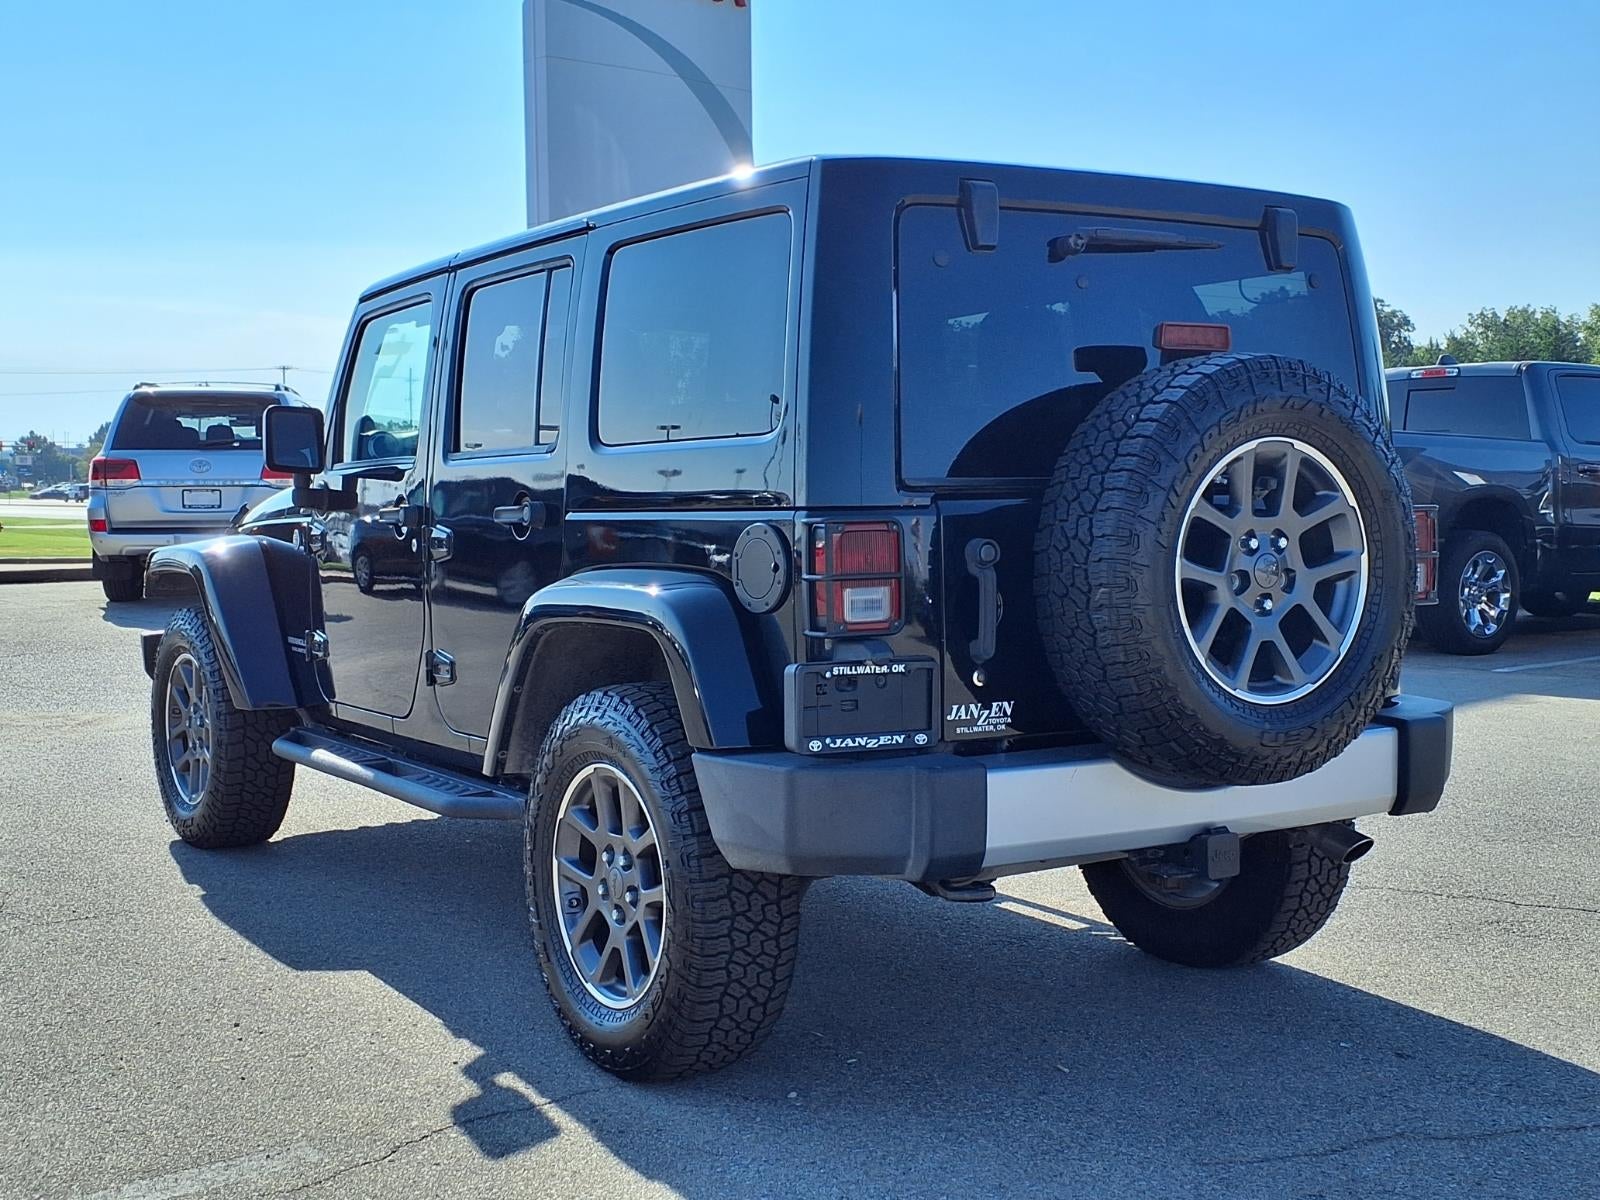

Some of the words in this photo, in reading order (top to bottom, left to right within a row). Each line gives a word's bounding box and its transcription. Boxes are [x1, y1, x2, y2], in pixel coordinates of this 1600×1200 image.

[832, 664, 890, 676] STILLWATER,
[891, 663, 906, 673] OK
[946, 700, 1015, 726] JANZEN
[956, 725, 996, 734] STILLWATER,
[829, 734, 906, 748] JANZEN
